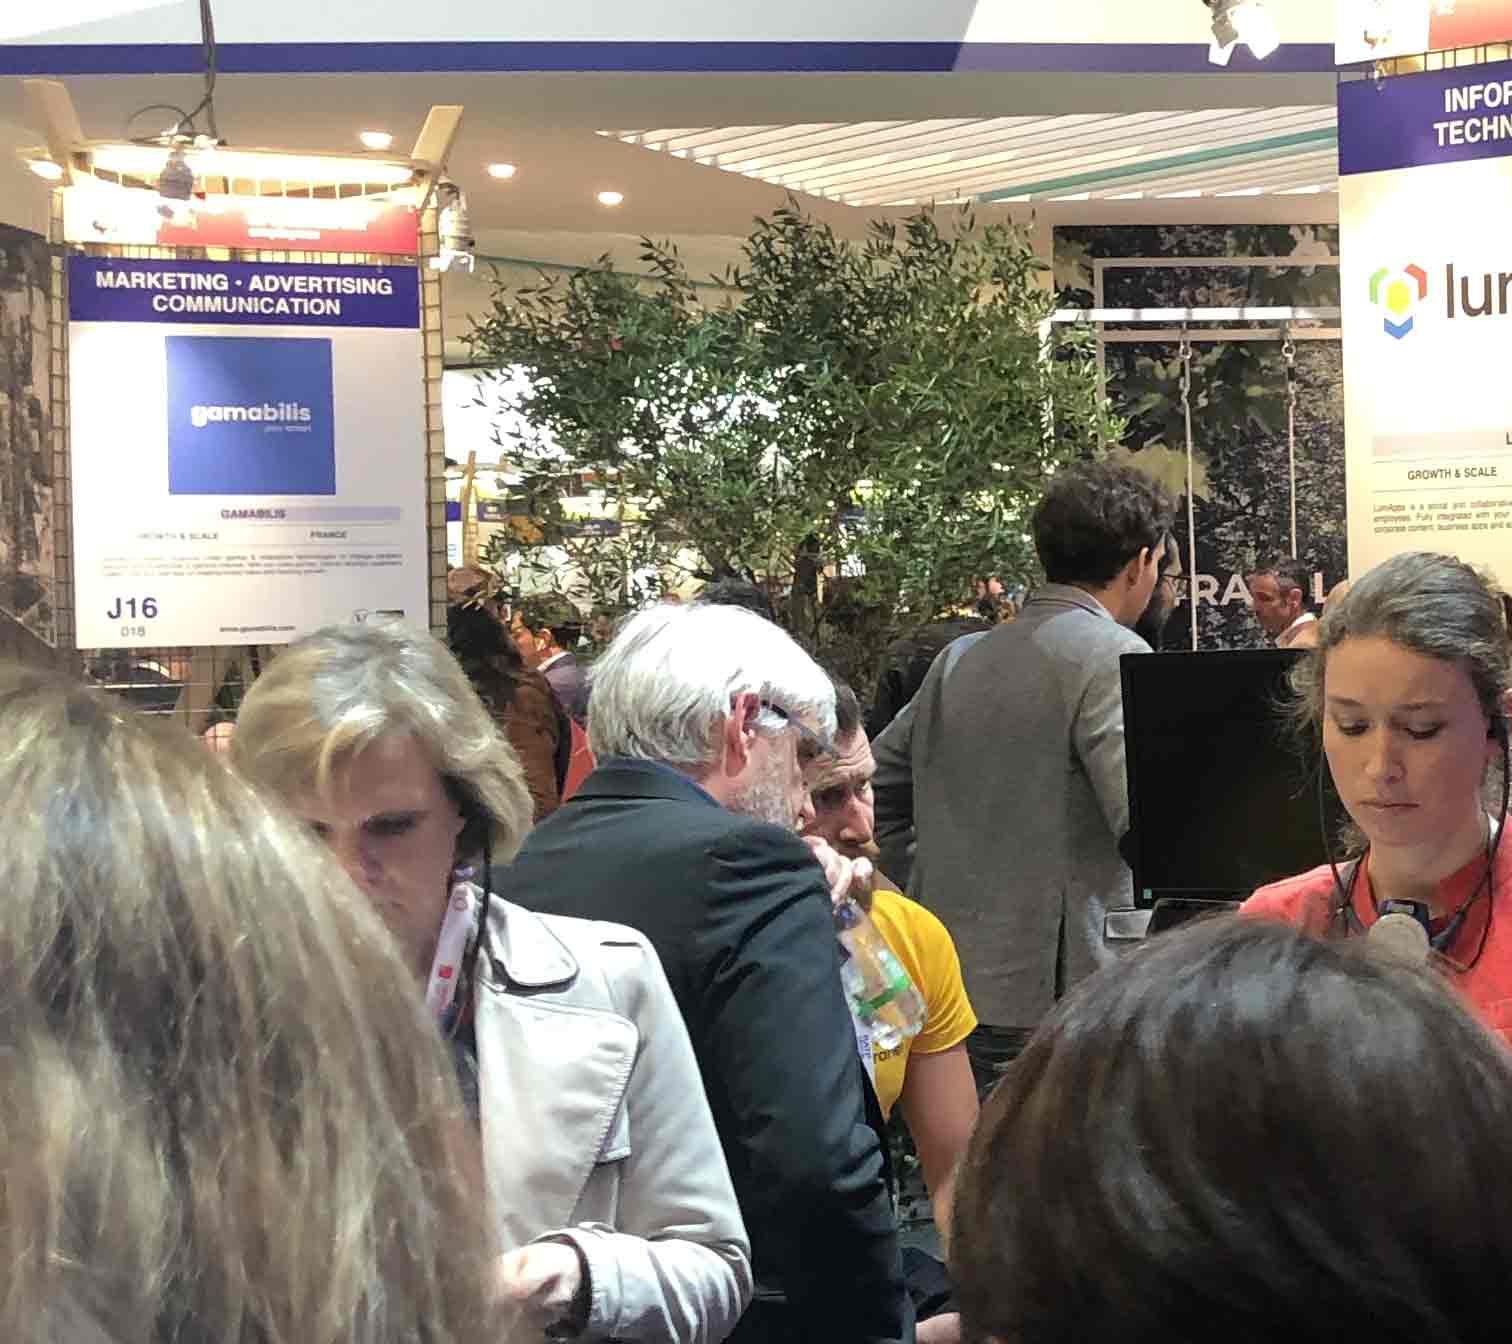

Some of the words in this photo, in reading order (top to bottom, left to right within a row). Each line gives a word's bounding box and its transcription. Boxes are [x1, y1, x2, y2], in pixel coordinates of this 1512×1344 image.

[95, 270, 229, 291] MARKETING
[249, 274, 393, 295] ADVERTISING
[153, 294, 341, 315] COMMUNICATION
[190, 403, 312, 428] gamabilis
[1407, 468, 1451, 481] GROWTH
[1464, 466, 1498, 478] SCALE
[106, 597, 159, 620] J16
